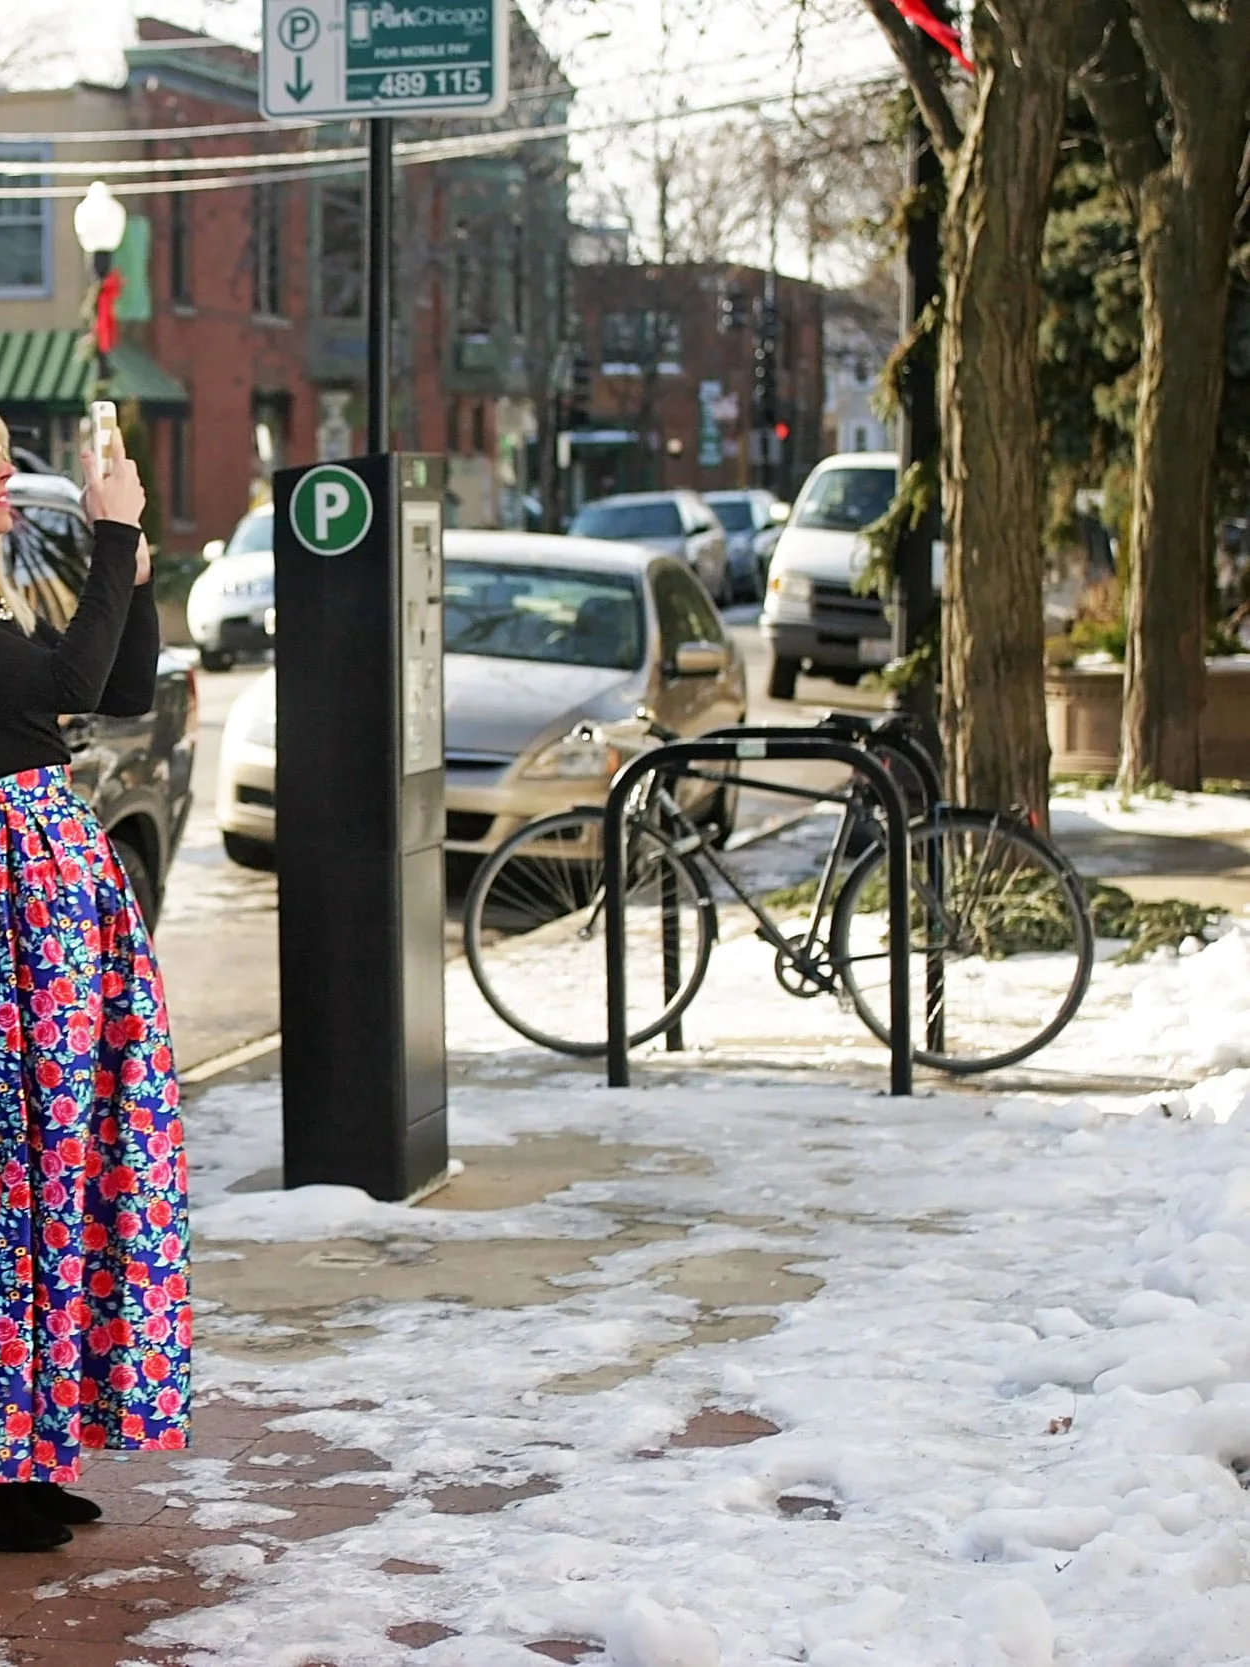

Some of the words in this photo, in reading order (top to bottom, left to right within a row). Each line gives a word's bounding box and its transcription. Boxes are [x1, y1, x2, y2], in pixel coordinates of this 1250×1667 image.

[371, 2, 488, 28] ParkChicago
[289, 15, 310, 44] P
[374, 46, 399, 59] FOR
[400, 44, 446, 58] MOBILE
[378, 72, 427, 97] 489
[434, 69, 482, 94] 115
[314, 482, 350, 541] P
